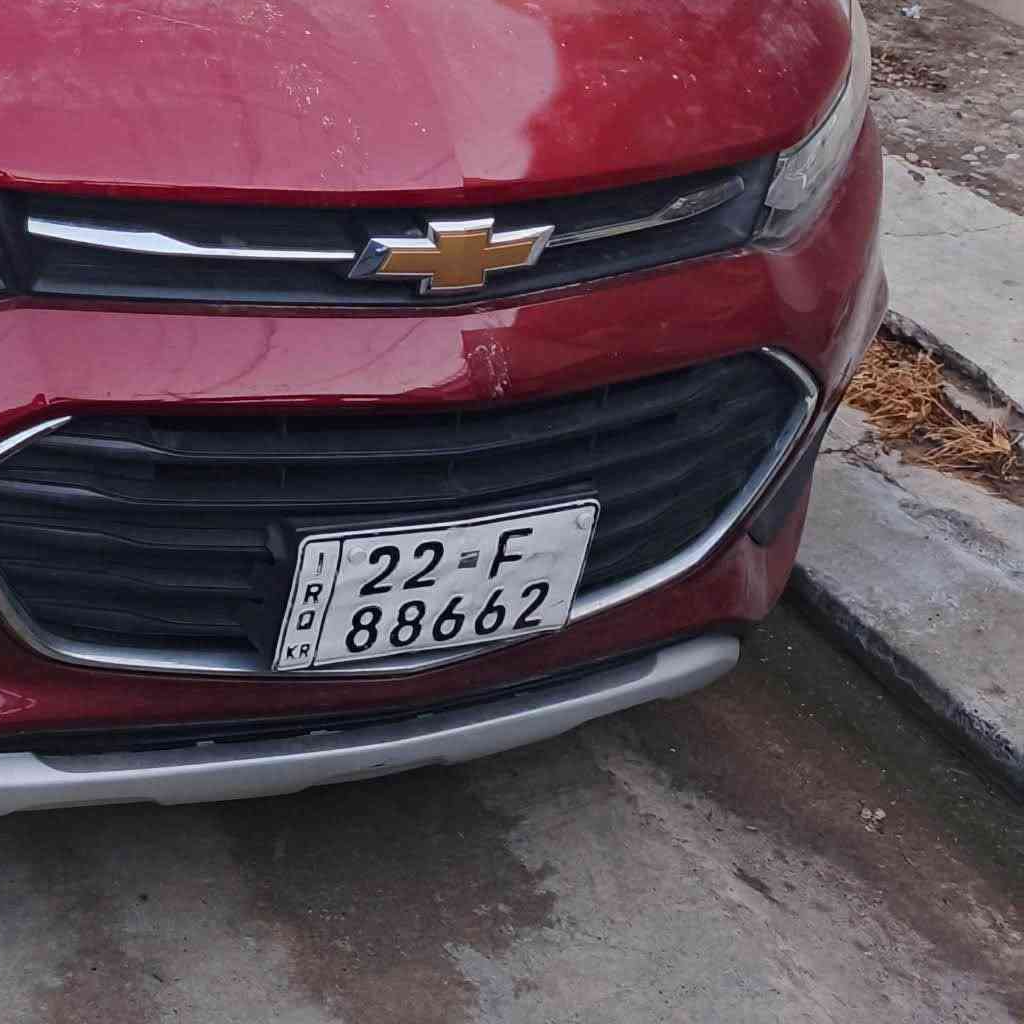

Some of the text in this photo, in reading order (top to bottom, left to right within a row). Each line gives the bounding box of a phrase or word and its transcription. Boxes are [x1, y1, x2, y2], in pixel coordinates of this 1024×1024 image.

[359, 527, 534, 597] 22 F
[286, 643, 312, 660] KR
[345, 581, 550, 654] 88662
